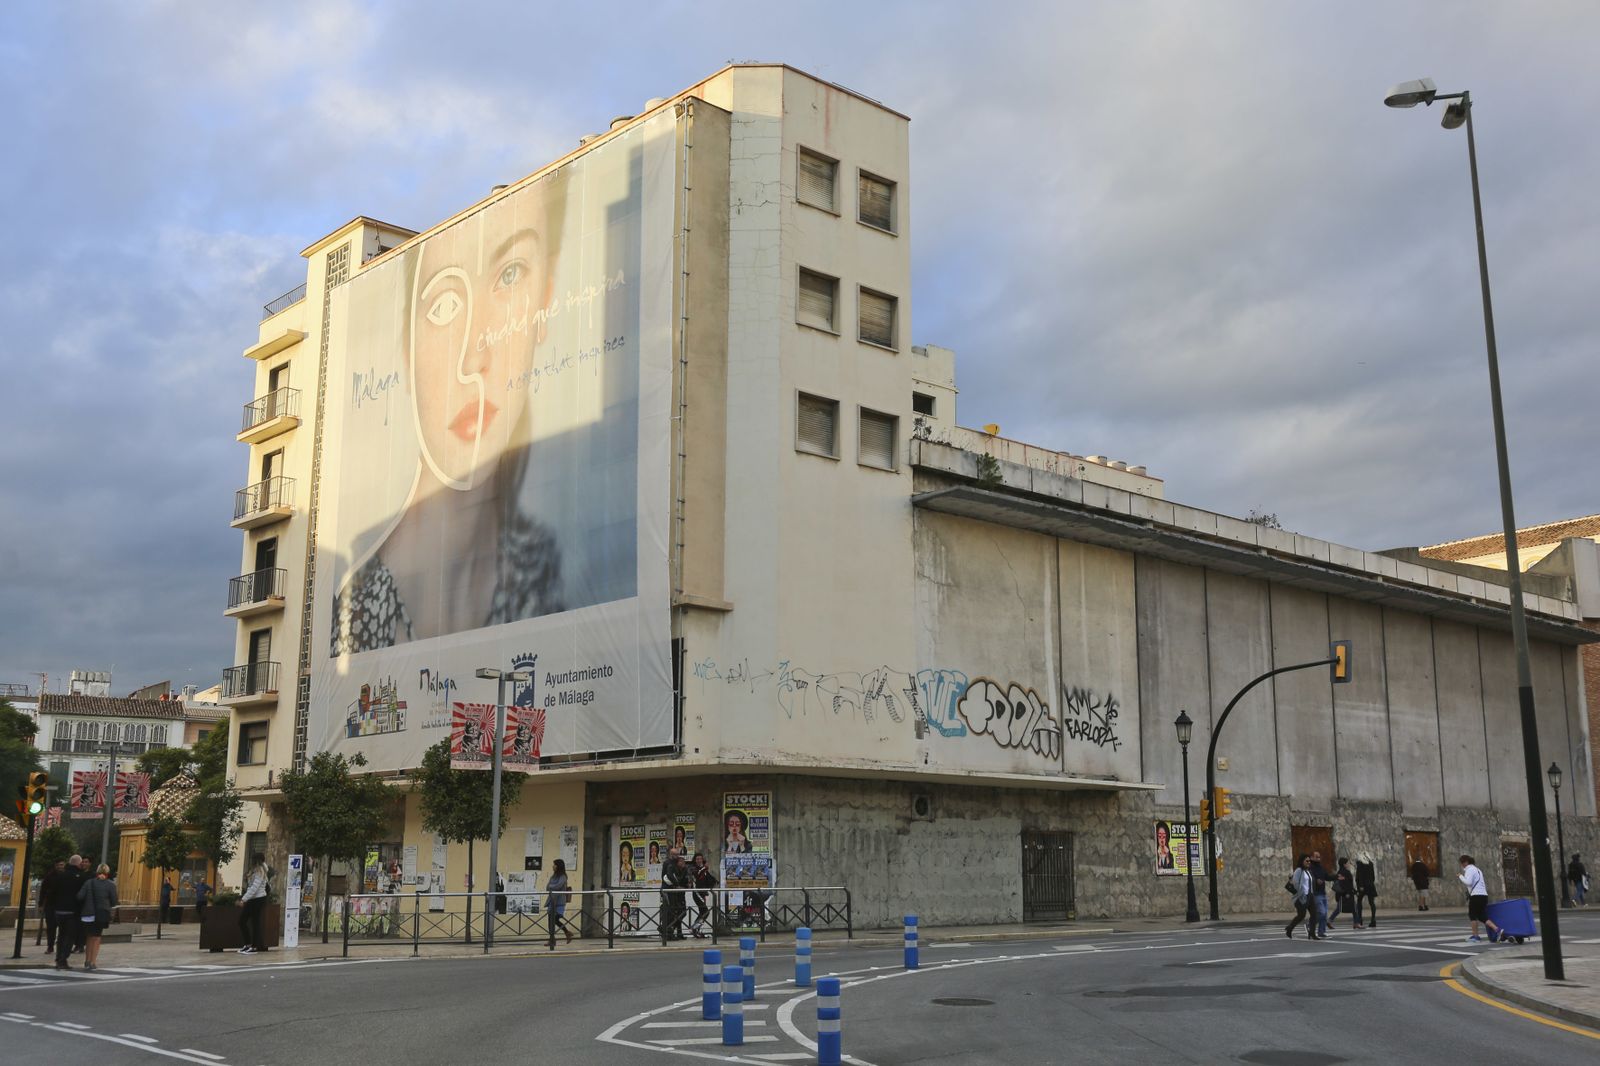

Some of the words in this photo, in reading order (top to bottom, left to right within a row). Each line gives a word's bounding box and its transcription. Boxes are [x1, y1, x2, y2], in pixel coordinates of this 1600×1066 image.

[532, 299, 560, 343] que
[566, 269, 626, 328] inspira
[544, 346, 573, 374] that
[352, 367, 400, 426] Málaga
[544, 664, 613, 687] Ayuntamiento
[419, 668, 457, 709] Málaga
[544, 692, 556, 708] de
[558, 689, 595, 707] Málaga
[726, 794, 768, 804] STOCK!
[621, 826, 645, 835] STOCK!
[1171, 824, 1198, 834] STOK!
